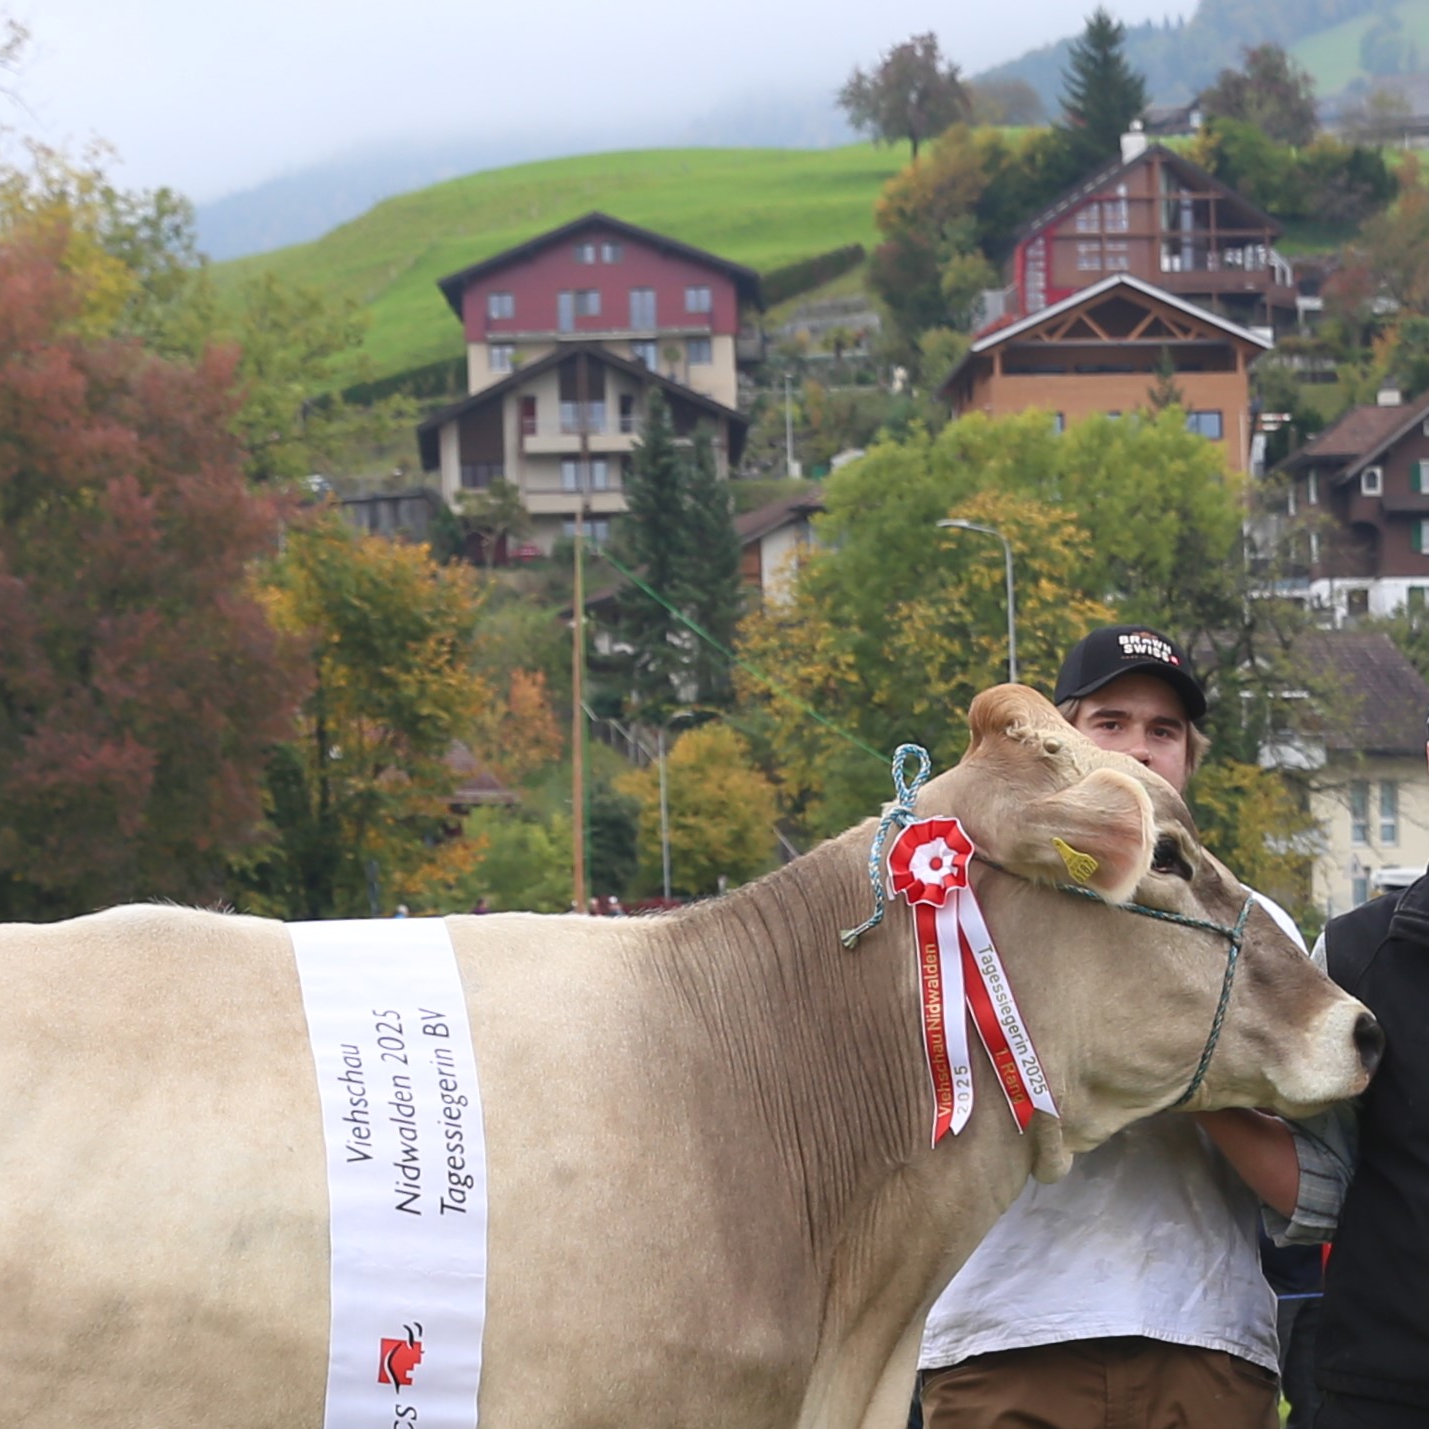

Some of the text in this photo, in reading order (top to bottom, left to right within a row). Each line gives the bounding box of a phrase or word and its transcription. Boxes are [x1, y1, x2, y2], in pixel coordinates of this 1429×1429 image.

[1123, 643, 1170, 663] SWISS
[923, 943, 950, 1118] Viehschau Nidwalden
[978, 943, 1048, 1096] Tagessiegerin 2025
[1001, 1063, 1026, 1105] Rang
[337, 1043, 373, 1164] Viehschau
[372, 1009, 422, 1216] Nidwalden 2025
[418, 1007, 474, 1215] Tagessiegerin BV
[954, 1065, 971, 1115] 2025
